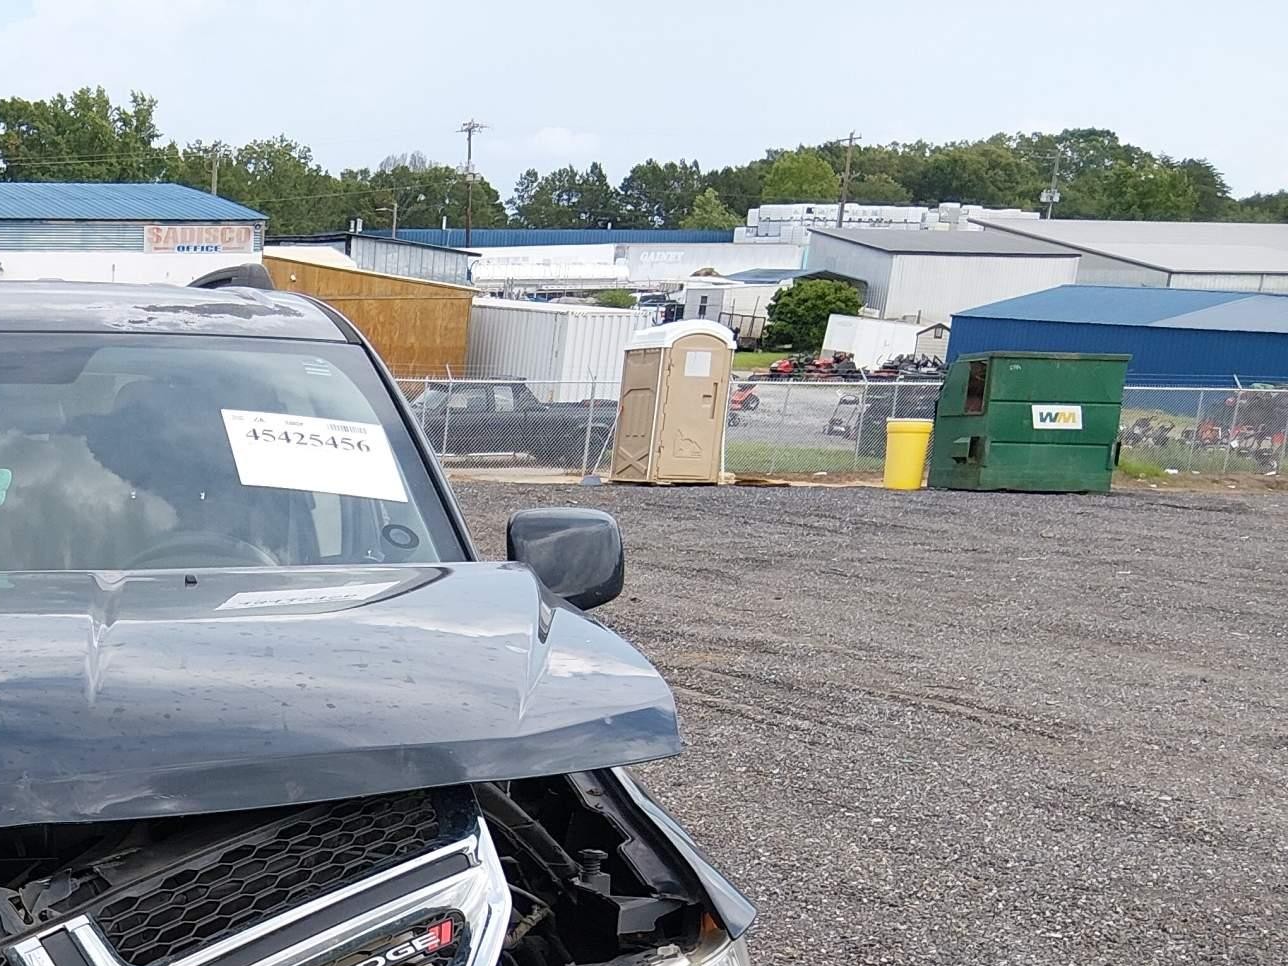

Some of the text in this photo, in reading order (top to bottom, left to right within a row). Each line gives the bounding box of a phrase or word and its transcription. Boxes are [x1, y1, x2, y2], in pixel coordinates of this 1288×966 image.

[147, 227, 251, 244] SADISCO
[1038, 411, 1076, 424] WM
[245, 427, 371, 453] 45425456
